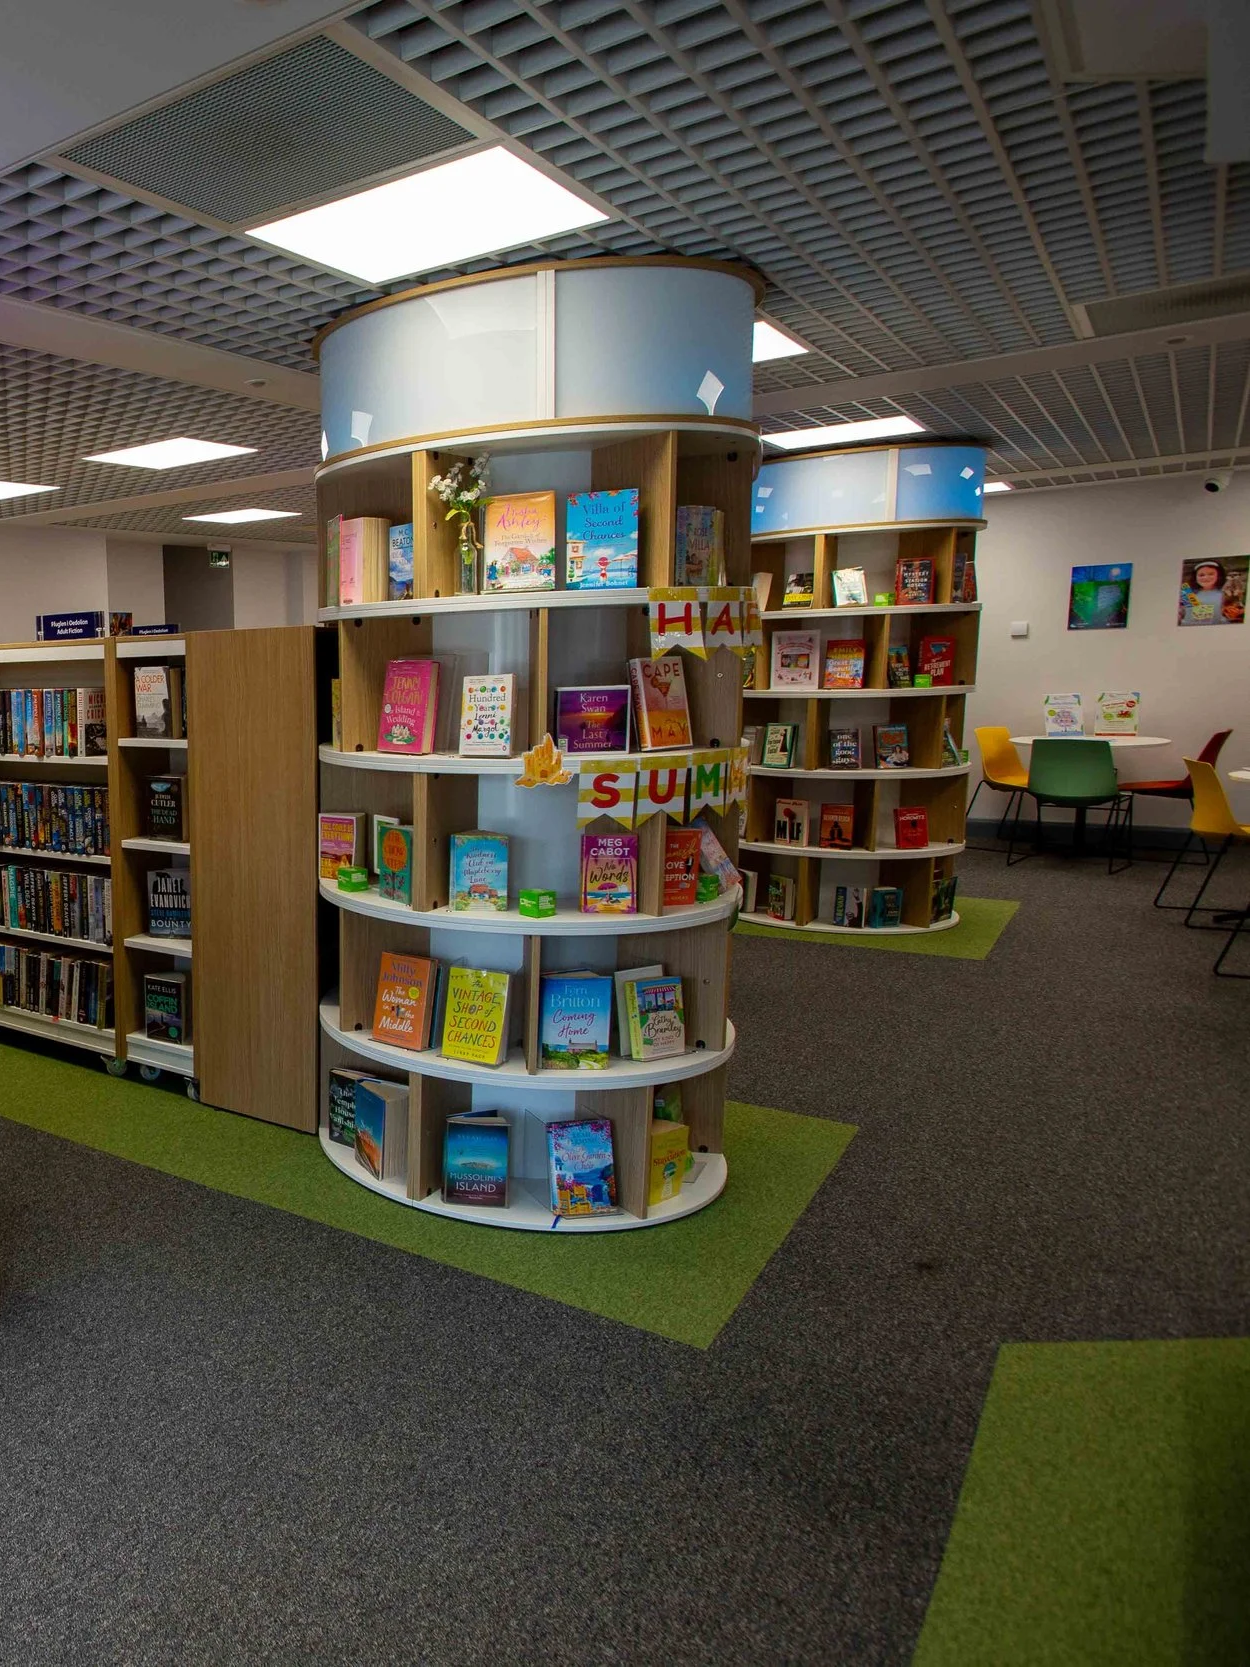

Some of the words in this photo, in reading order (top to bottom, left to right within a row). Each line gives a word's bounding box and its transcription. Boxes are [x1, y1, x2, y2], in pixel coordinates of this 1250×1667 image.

[582, 504, 610, 514] Villa
[613, 501, 626, 513] of
[497, 513, 543, 529] Ashley
[584, 516, 623, 527] Second
[582, 530, 625, 540] Chances
[579, 581, 606, 590] Jennifer
[607, 579, 628, 587] Bohnet
[642, 663, 680, 678] CAPE
[135, 675, 143, 684] A
[144, 674, 165, 684] COLDER
[136, 683, 152, 693] WAR
[468, 693, 506, 703] Hundred
[579, 693, 609, 703] Karen
[394, 705, 416, 716] Island
[581, 704, 606, 713] Swan
[386, 714, 416, 727] Wedding
[586, 720, 601, 729] The
[471, 723, 499, 739] Margot
[582, 729, 604, 740] Last
[651, 723, 687, 738] MAY
[573, 741, 612, 749] Summer
[832, 740, 841, 749] of
[844, 740, 857, 748] the
[835, 747, 855, 758] good
[150, 799, 176, 808] CUTLER
[153, 816, 175, 825] HAND
[598, 838, 623, 847] MEG
[589, 847, 630, 857] CABOT
[604, 862, 617, 870] No
[469, 876, 487, 885] Lane
[589, 868, 629, 884] Words
[8, 868, 16, 898] MAGPIE
[157, 877, 183, 893] JANET
[150, 919, 191, 928] BOUNTY
[391, 960, 416, 976] Milly
[382, 972, 423, 988] Johnson
[147, 984, 160, 992] KATE
[162, 986, 177, 994] ELLIS
[395, 986, 406, 995] The
[564, 984, 588, 995] Fern
[146, 994, 177, 1006] COFFIN
[381, 988, 417, 1007] Woman
[452, 988, 501, 1005] VINTAGE
[551, 994, 601, 1009] Britton
[146, 1002, 178, 1014] ISLAND
[453, 1001, 483, 1014] SHOP
[485, 1007, 494, 1018] of
[405, 1011, 415, 1019] the
[552, 1009, 597, 1027] Coming
[653, 1013, 673, 1026] Cathy
[378, 1016, 414, 1034] Middle
[449, 1016, 497, 1033] SECOND
[644, 1022, 682, 1038] Bramley
[557, 1023, 590, 1038] Home
[447, 1031, 496, 1049] CHANCES
[338, 1087, 354, 1098] The
[561, 1152, 580, 1162] Olive
[653, 1150, 687, 1167] Staycation
[449, 1171, 503, 1183] MUSSOLINI'S
[455, 1181, 497, 1193] ISLAND
